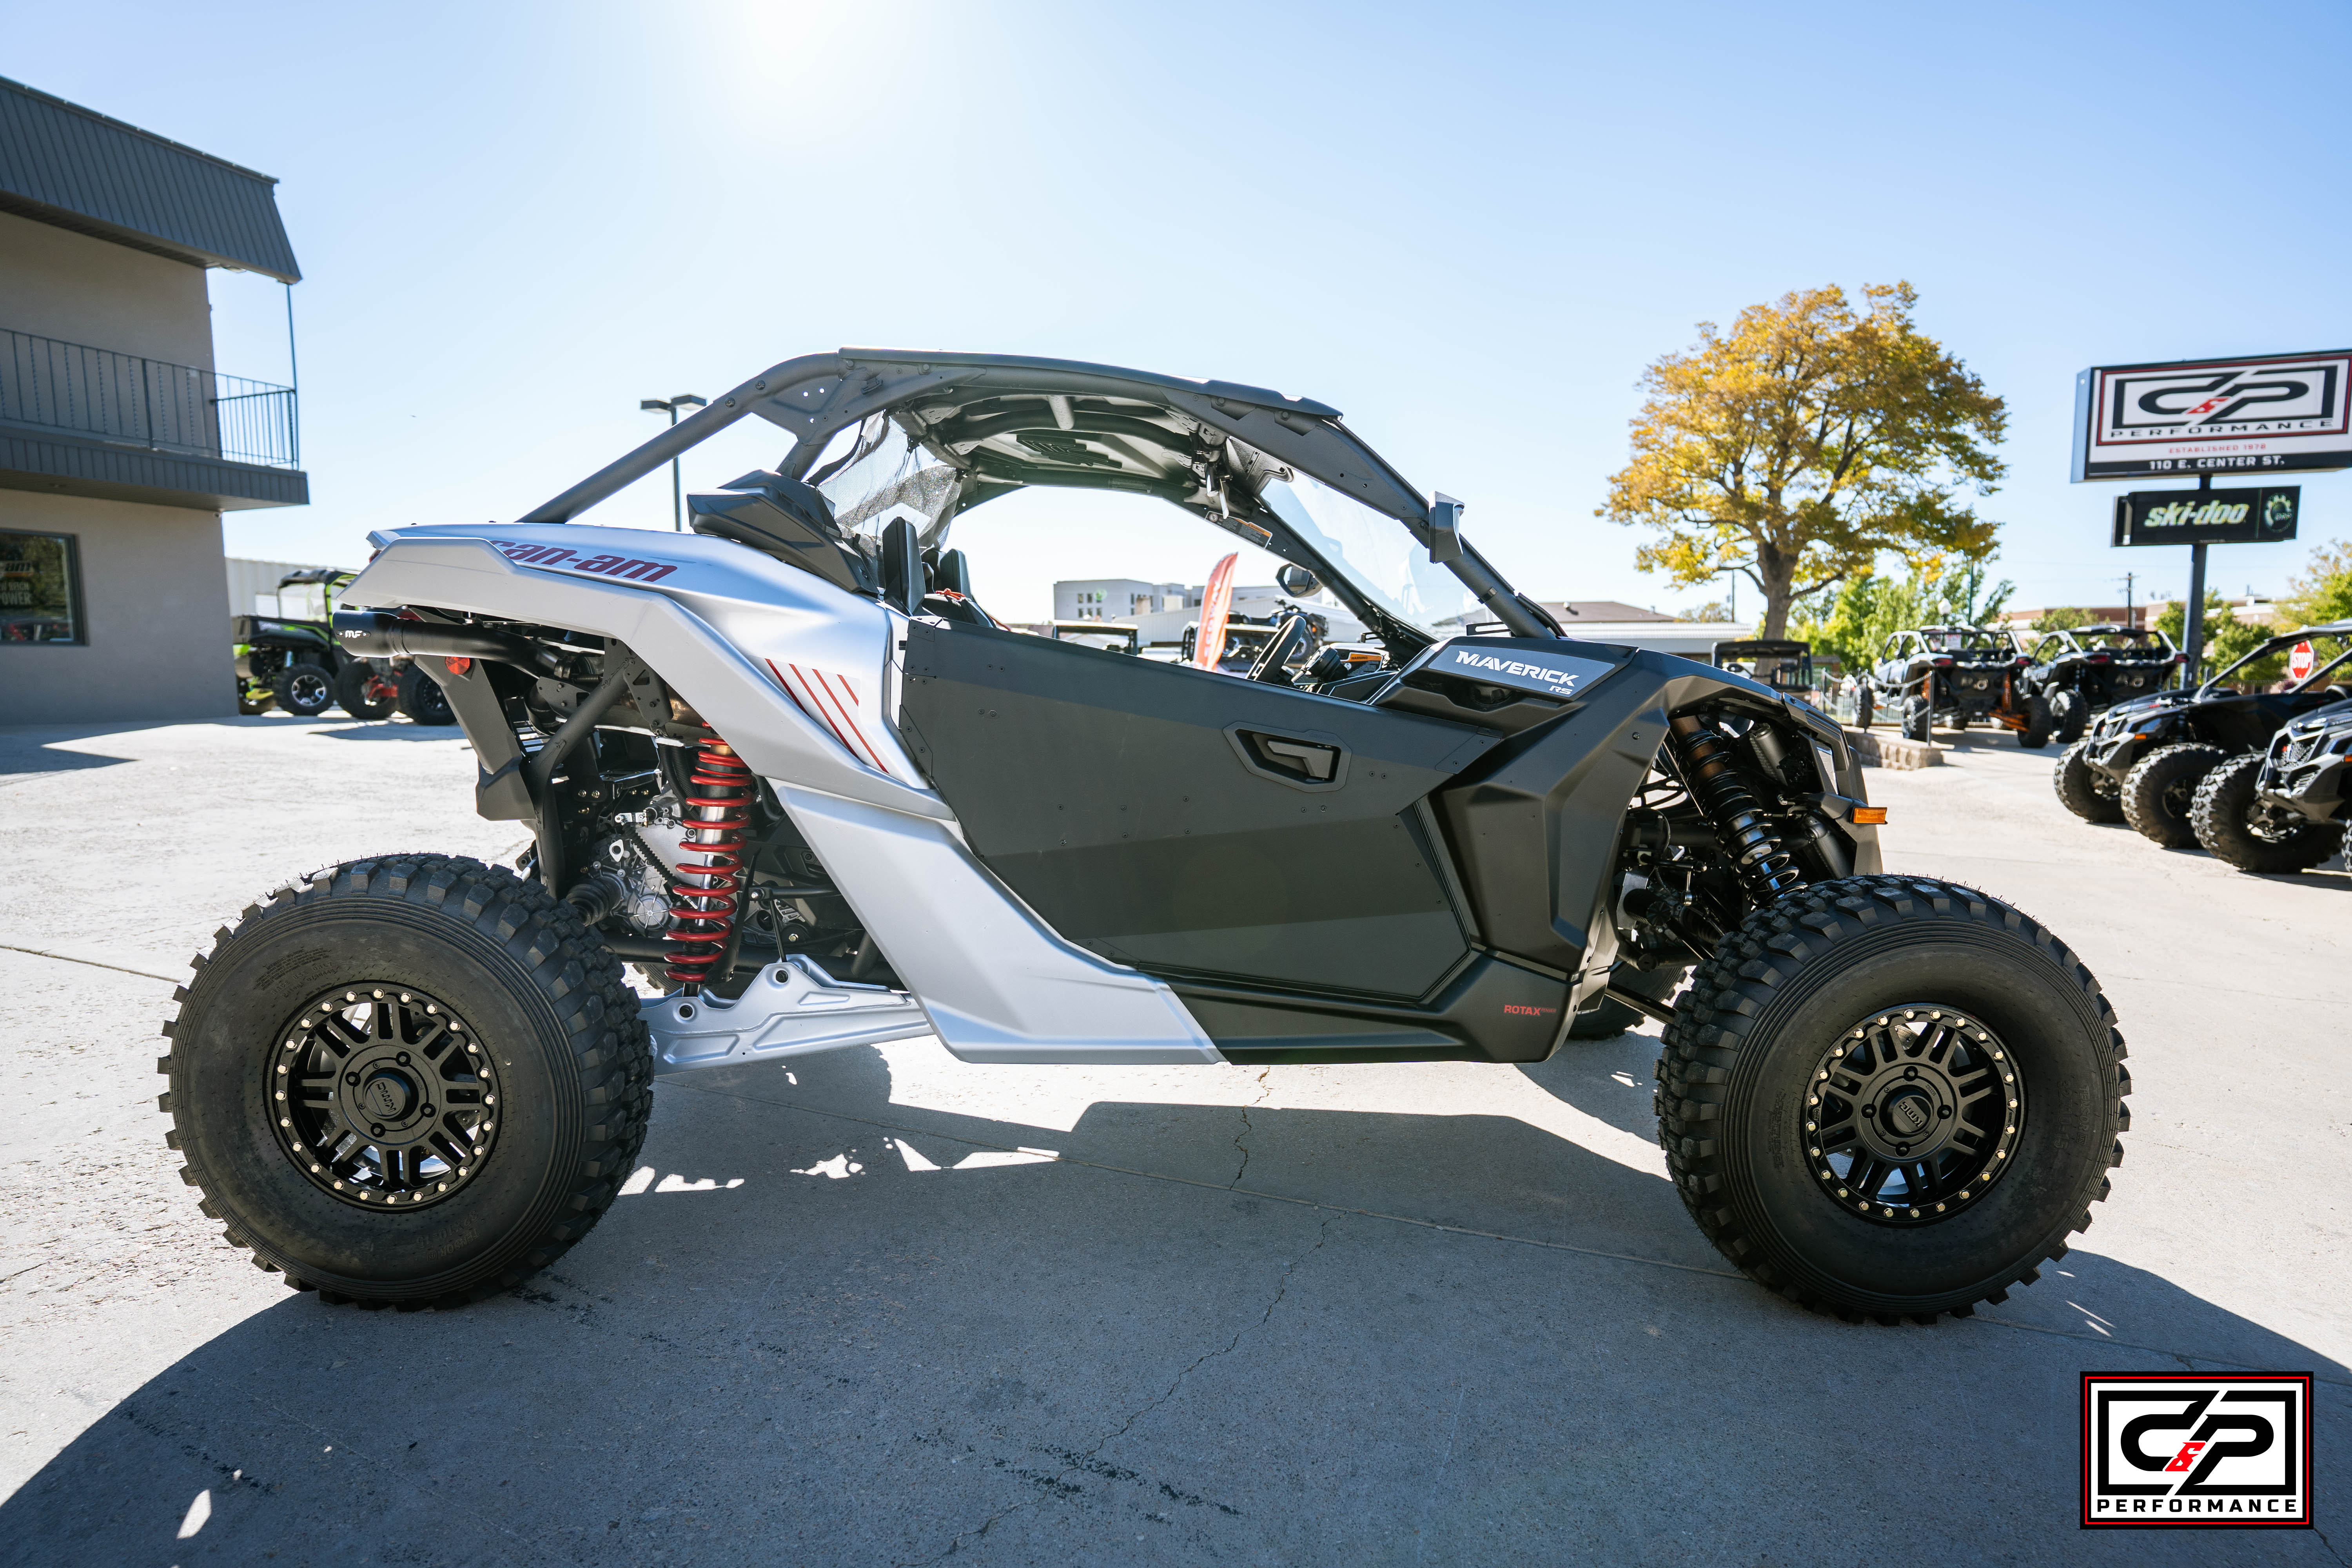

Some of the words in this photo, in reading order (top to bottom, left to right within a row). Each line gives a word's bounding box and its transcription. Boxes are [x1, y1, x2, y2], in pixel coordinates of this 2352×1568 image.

[2111, 419, 2333, 437] PERFORMANCE
[2169, 445, 2238, 454] ESTABLISHED
[2150, 460, 2172, 470] 110
[2178, 459, 2191, 469] E.
[2197, 456, 2256, 468] CENTER
[2144, 500, 2250, 527] ski-doo
[2292, 652, 2312, 668] STOP
[1455, 650, 1579, 687] MAVERICK
[1549, 685, 1573, 695] RS
[1504, 1005, 1541, 1016] ROTAX
